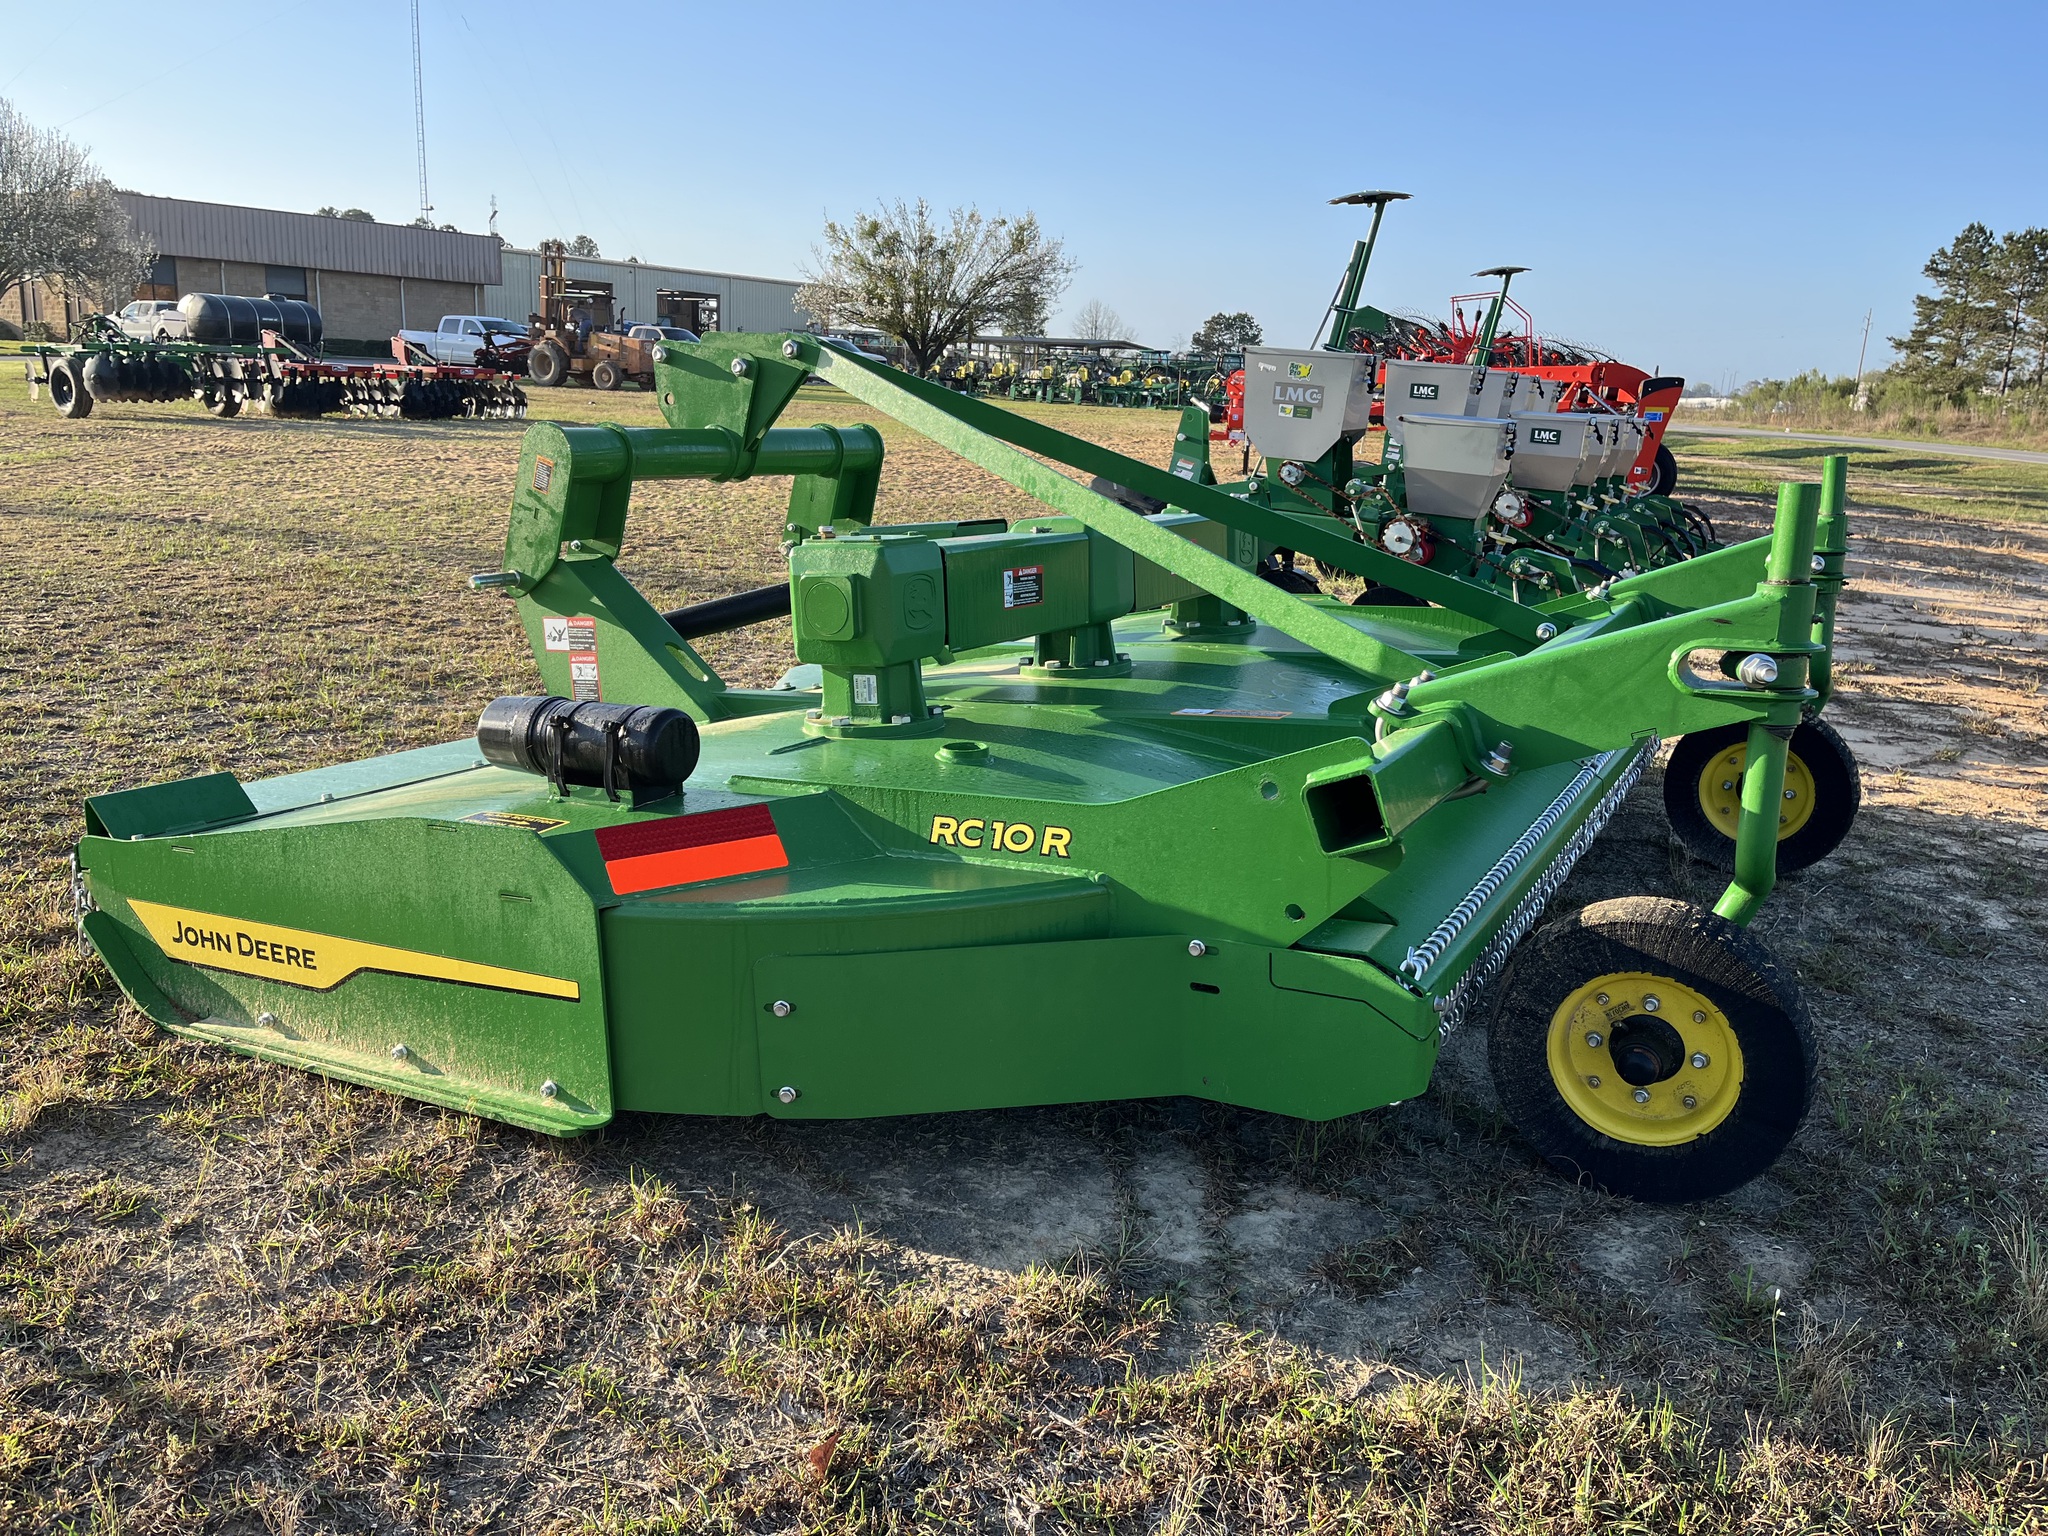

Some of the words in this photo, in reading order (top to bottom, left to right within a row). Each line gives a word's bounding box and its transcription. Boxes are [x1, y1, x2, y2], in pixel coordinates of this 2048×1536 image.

[1274, 386, 1319, 404] LMC
[1413, 385, 1435, 395] LMC
[1534, 430, 1557, 440] LMC
[172, 920, 233, 954] JOHN
[236, 932, 318, 971] DEERE
